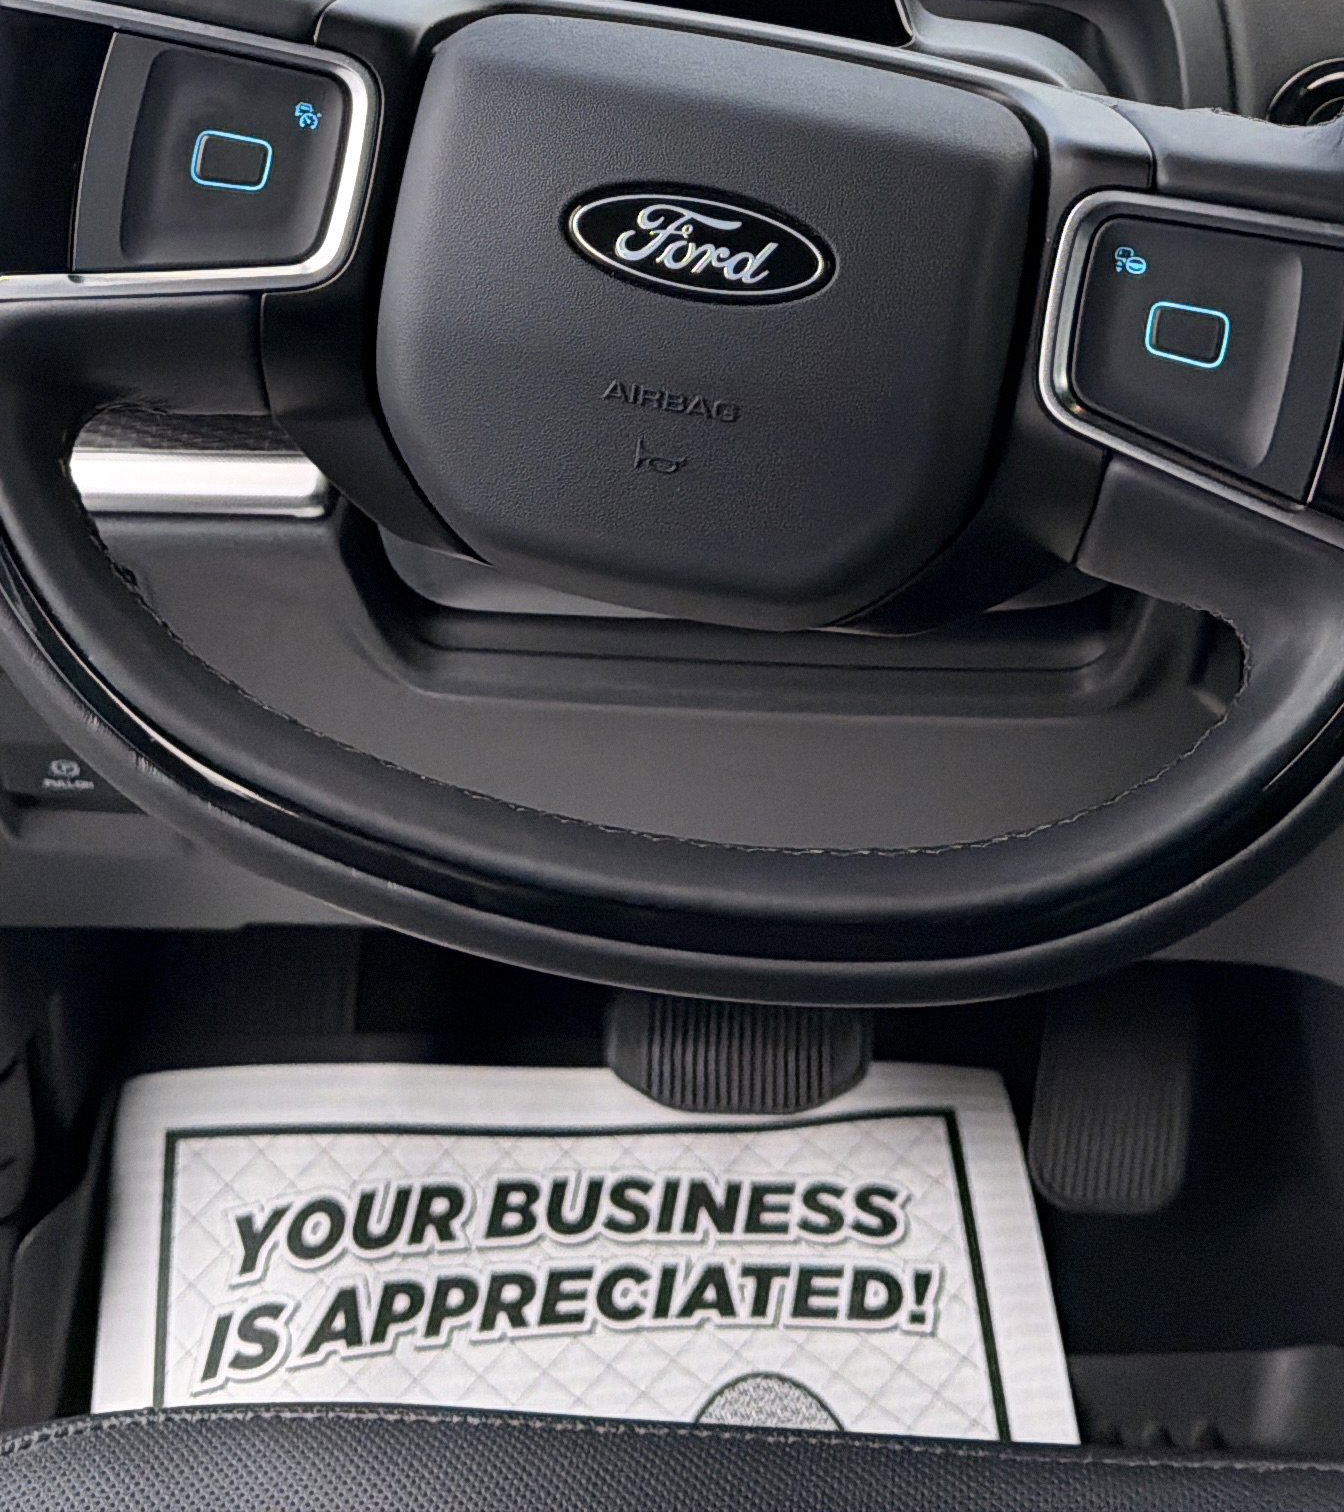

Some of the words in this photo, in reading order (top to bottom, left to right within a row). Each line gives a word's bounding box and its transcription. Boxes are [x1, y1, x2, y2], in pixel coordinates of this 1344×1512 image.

[615, 203, 779, 284] Ford
[601, 379, 741, 423] AIRBAG
[233, 1182, 467, 1276] YOUR
[484, 1177, 907, 1240] BUSINESS
[200, 1300, 288, 1383] IS
[301, 1263, 936, 1358] APPRECIATED!
